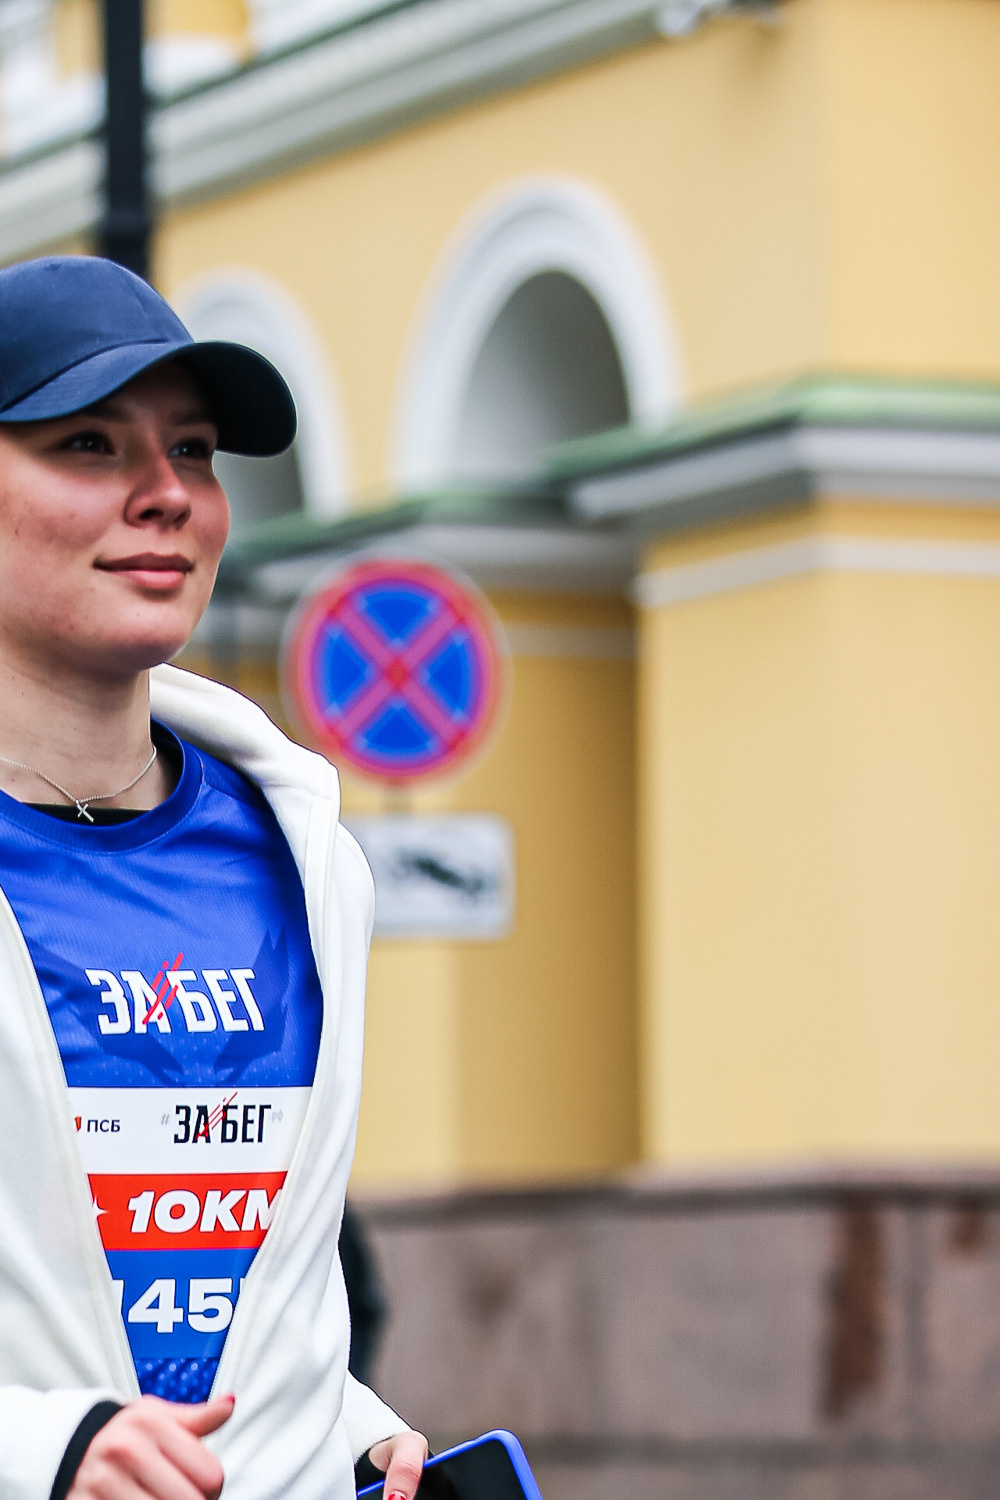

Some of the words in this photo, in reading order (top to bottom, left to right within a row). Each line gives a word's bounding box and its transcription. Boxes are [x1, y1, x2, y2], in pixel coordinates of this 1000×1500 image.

[85, 968, 265, 1035] ЗАБЕГ
[86, 1119, 121, 1133] ПСБ
[113, 1277, 245, 1333] 45
